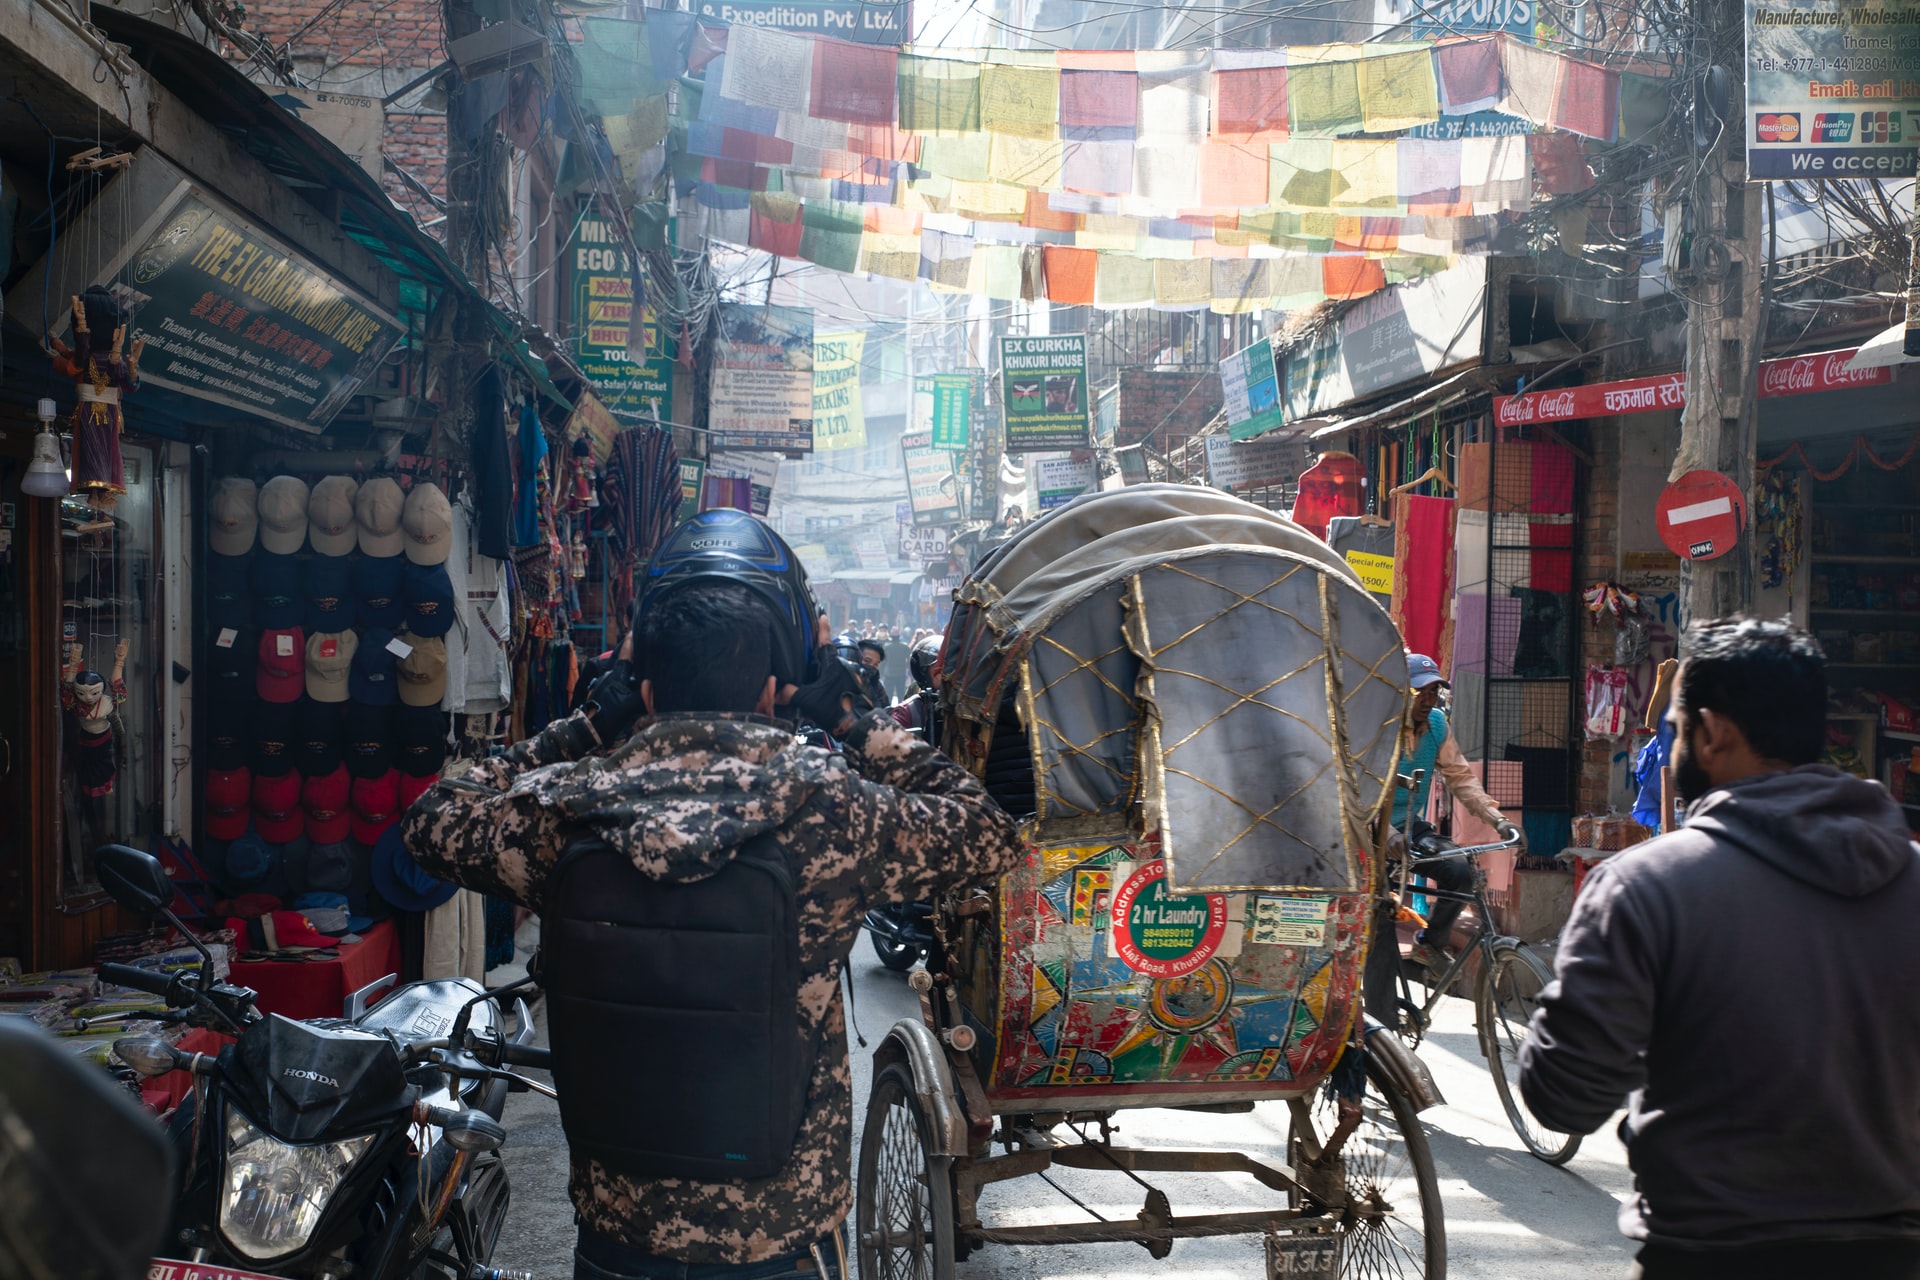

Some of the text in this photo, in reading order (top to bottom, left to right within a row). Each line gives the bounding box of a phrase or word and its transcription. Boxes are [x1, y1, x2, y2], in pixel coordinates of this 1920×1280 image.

[722, 5, 817, 27] Expedition
[823, 9, 854, 28] Pvt.
[864, 11, 899, 30] Ltd.
[1755, 9, 1845, 28] Manufacturer,
[1843, 36, 1896, 50] Thamel,
[1757, 58, 1780, 71] Tel:
[1783, 57, 1888, 71] +977-1-4412804
[1809, 80, 1859, 97] Email:
[329, 96, 372, 109] 4-700750
[1758, 124, 1799, 132] MasterCard
[1815, 119, 1852, 129] UnionPay
[1861, 121, 1900, 133] JCB
[1791, 152, 1913, 173] We accept
[576, 247, 616, 272] ECO
[190, 224, 244, 277] THE
[219, 242, 263, 288] EX
[243, 253, 306, 315] GURKHA
[291, 274, 355, 337] KHUKURI
[331, 307, 381, 354] HOUSE
[130, 327, 166, 348] E-mail:
[159, 316, 197, 342] Thamel,
[193, 331, 240, 360] Kathmandu,
[238, 349, 262, 369] Nepal,
[1005, 338, 1083, 353] EX GURKHA
[814, 341, 848, 363] IRST
[1005, 354, 1083, 369] KHUKURI HOUSE
[167, 360, 203, 382] Website:
[604, 379, 627, 390] Safari
[644, 380, 667, 392] Ticket
[1537, 391, 1576, 419] Coca-Cola
[827, 414, 852, 437] LTD.
[680, 464, 700, 481] TREK
[973, 422, 985, 508] HIMALAYAN
[908, 529, 936, 541] SIM
[691, 539, 738, 550] YOHE
[902, 541, 945, 554] CARD
[1347, 556, 1394, 570] Special offer
[1361, 576, 1389, 588] 1500/-
[1113, 863, 1226, 929] Address-To Park
[1131, 904, 1207, 930] 2 hr Laundry
[1121, 944, 1212, 975] Link Road, Khusibu
[284, 1068, 340, 1089] HONDA
